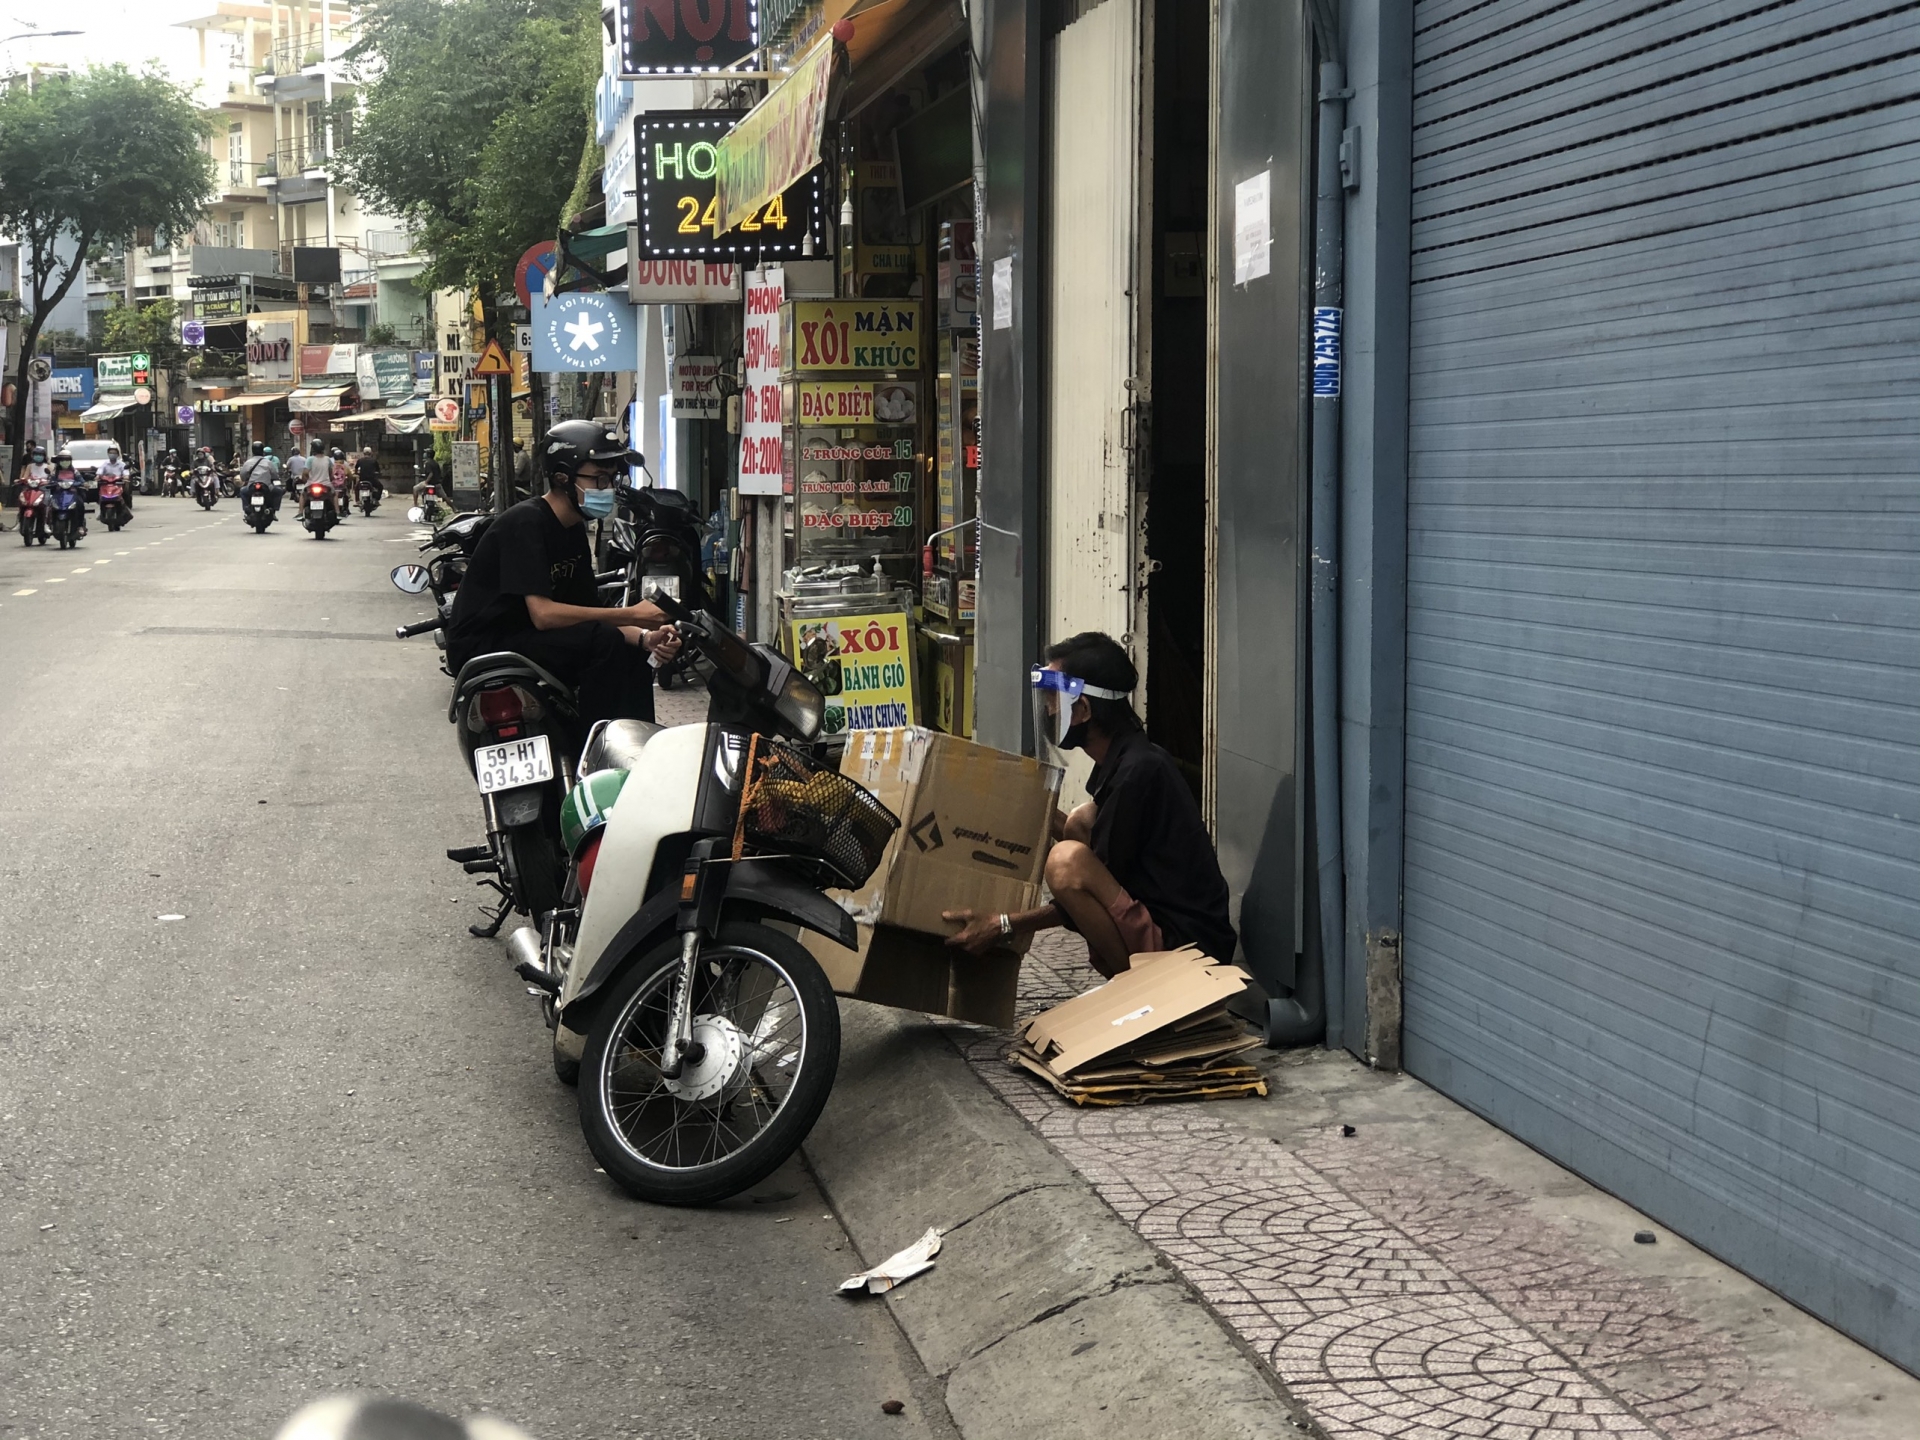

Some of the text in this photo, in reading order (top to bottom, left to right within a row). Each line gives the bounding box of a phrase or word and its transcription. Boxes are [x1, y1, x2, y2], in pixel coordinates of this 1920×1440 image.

[655, 142, 718, 180] HO
[677, 194, 788, 234] 2424
[559, 296, 605, 313] SOI THAI
[800, 305, 915, 366] XÔI MẶN
[561, 353, 607, 368] SOI THAI
[853, 340, 916, 367] KHÚC
[681, 380, 695, 392] FOR
[802, 384, 873, 423] ĐẶC BIỆT
[741, 437, 759, 475] 2h:
[802, 447, 810, 460] 2
[894, 440, 913, 459] 15
[893, 472, 912, 492] 17
[803, 506, 913, 531] ĐẶC BIỆT 20
[840, 620, 901, 654] XÔI
[843, 656, 905, 691] BÁNH GIÒ
[846, 699, 874, 730] BÁNH
[486, 741, 537, 768] 59-H1
[483, 759, 549, 790] 934.34
